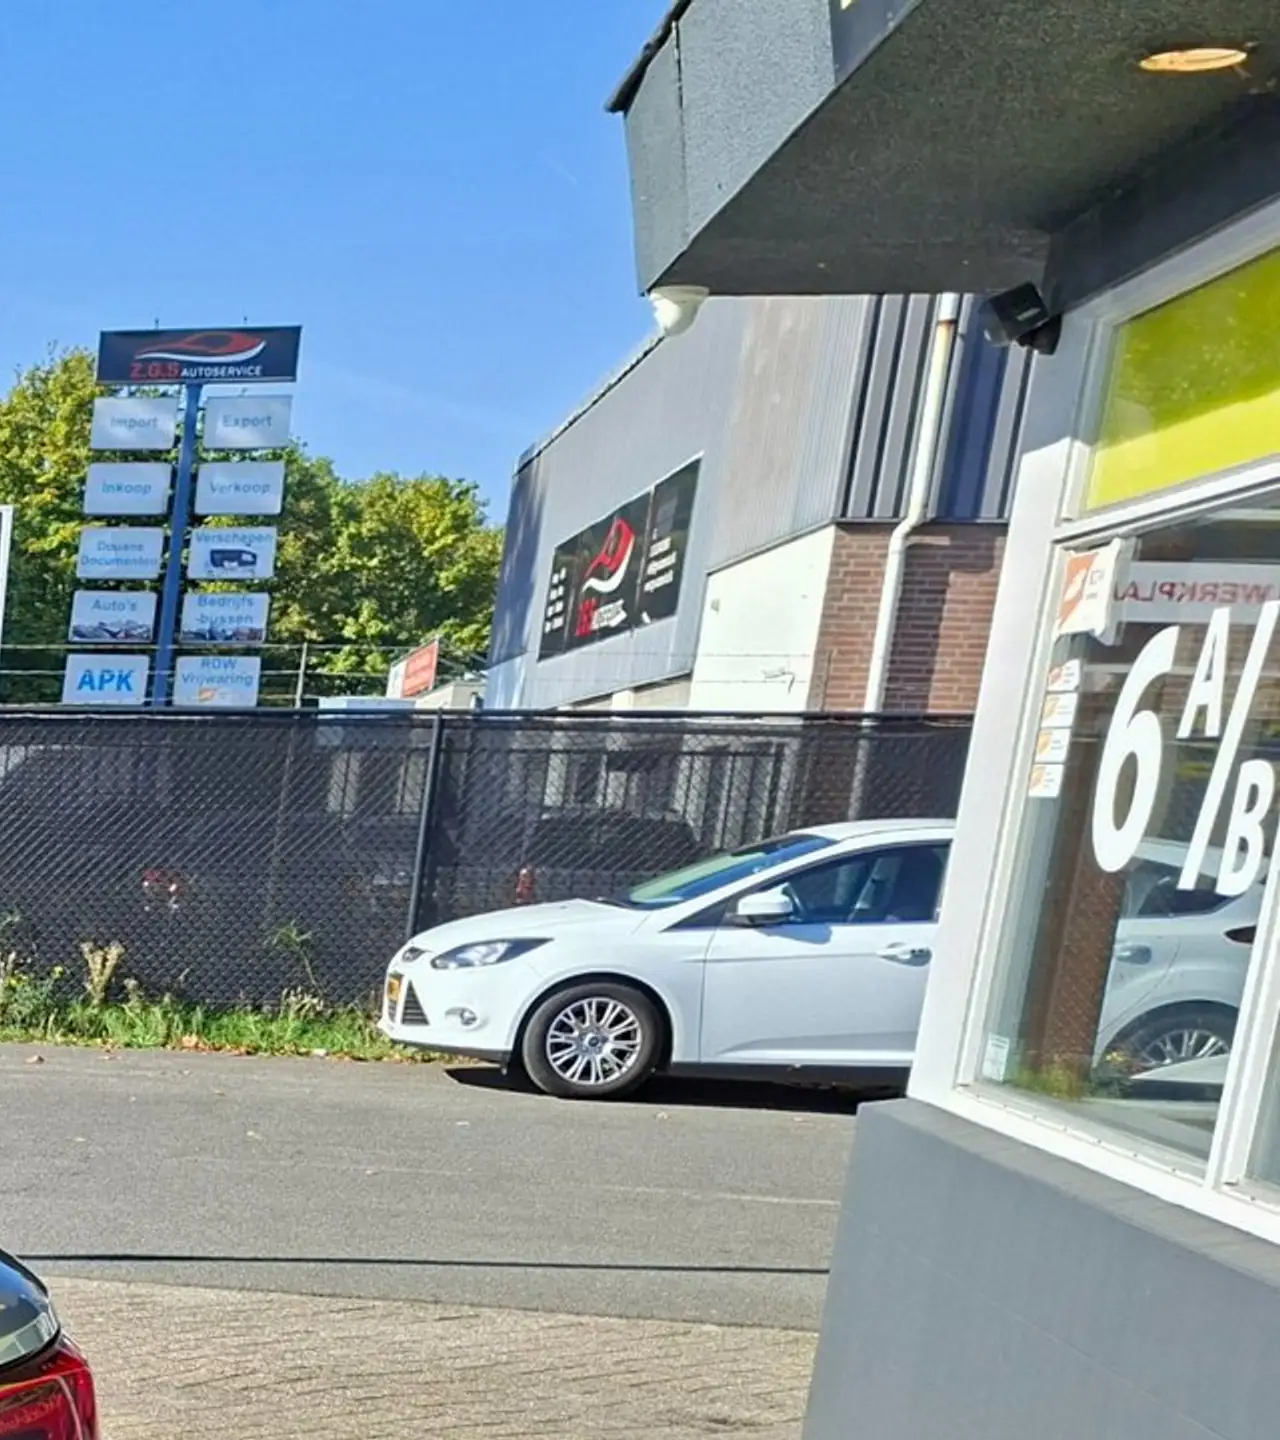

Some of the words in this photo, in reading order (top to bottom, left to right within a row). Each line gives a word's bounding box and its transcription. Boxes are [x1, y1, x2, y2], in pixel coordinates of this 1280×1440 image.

[181, 366, 263, 378] AUTOSERVICE
[110, 416, 158, 430] Import
[222, 414, 273, 429] Export
[102, 482, 152, 496] Inkoop
[209, 481, 272, 495] Verkoop
[92, 599, 138, 612] Auto's
[76, 669, 134, 692] APK
